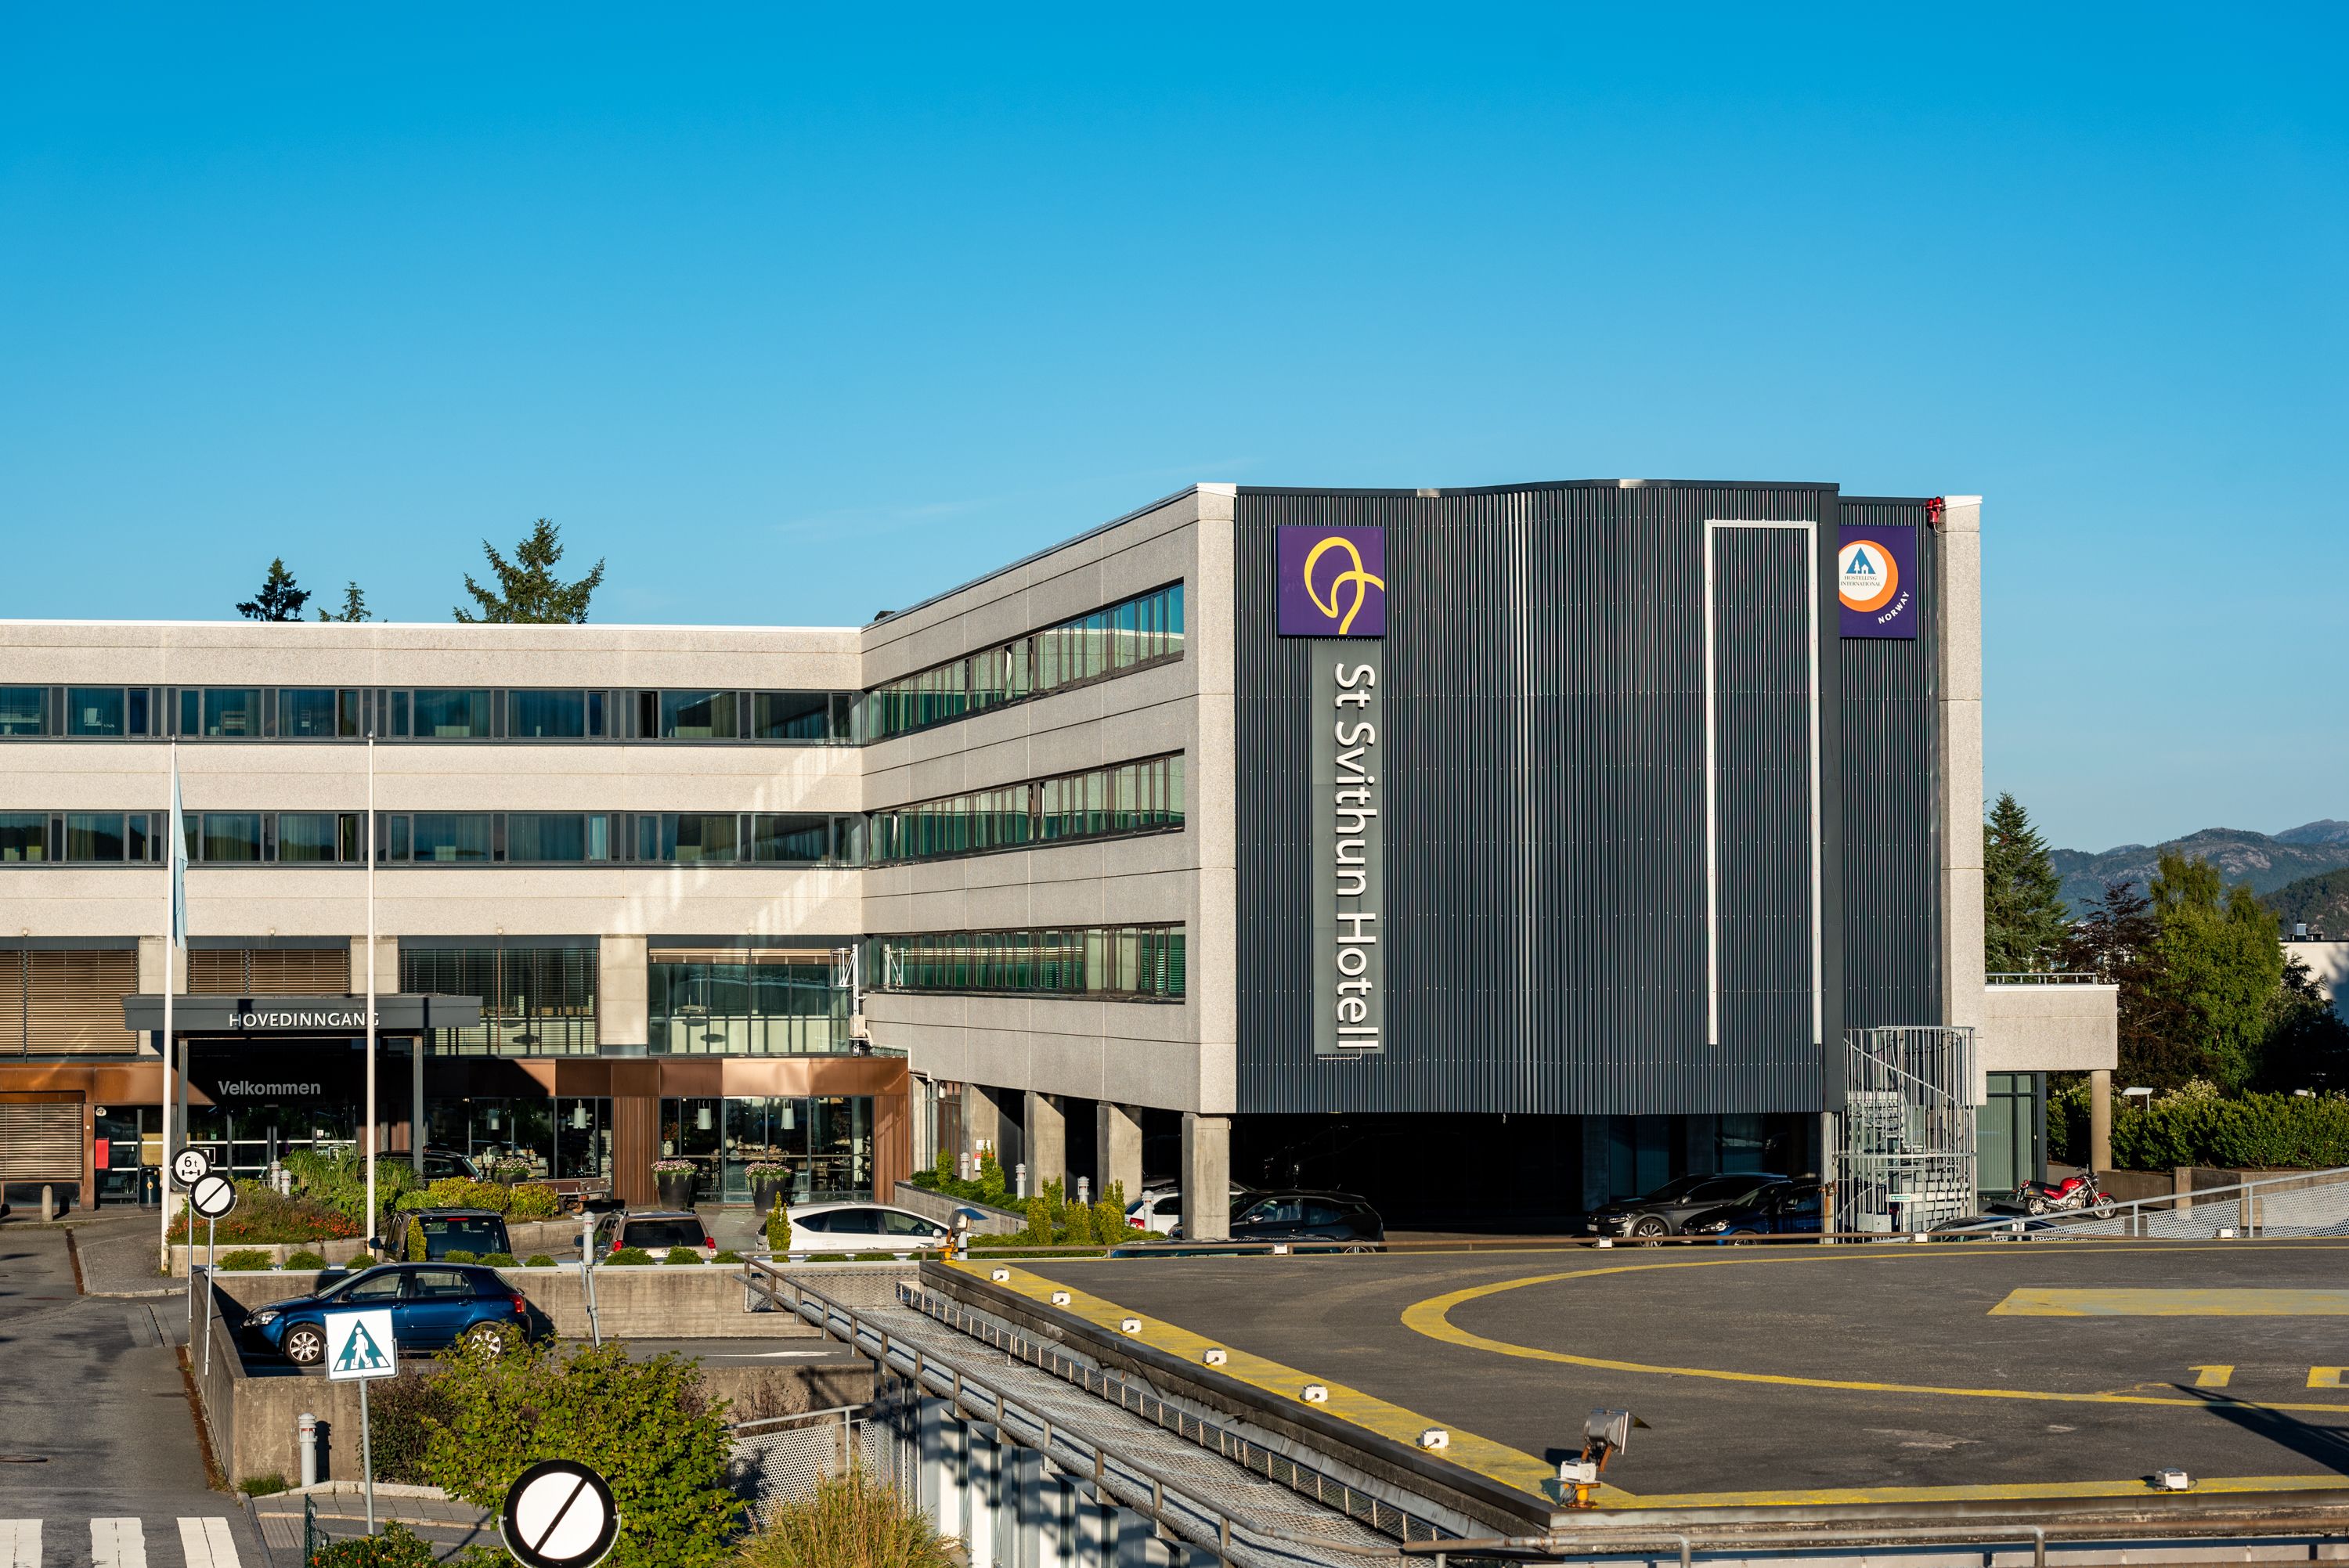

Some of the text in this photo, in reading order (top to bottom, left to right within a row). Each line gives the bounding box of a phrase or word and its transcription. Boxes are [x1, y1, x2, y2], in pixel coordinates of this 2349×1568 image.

[1878, 591, 1910, 624] NORWAY
[1335, 663, 1379, 1047] St Svithun Hotell
[218, 1080, 321, 1095] Velkommen
[184, 1156, 192, 1167] 6
